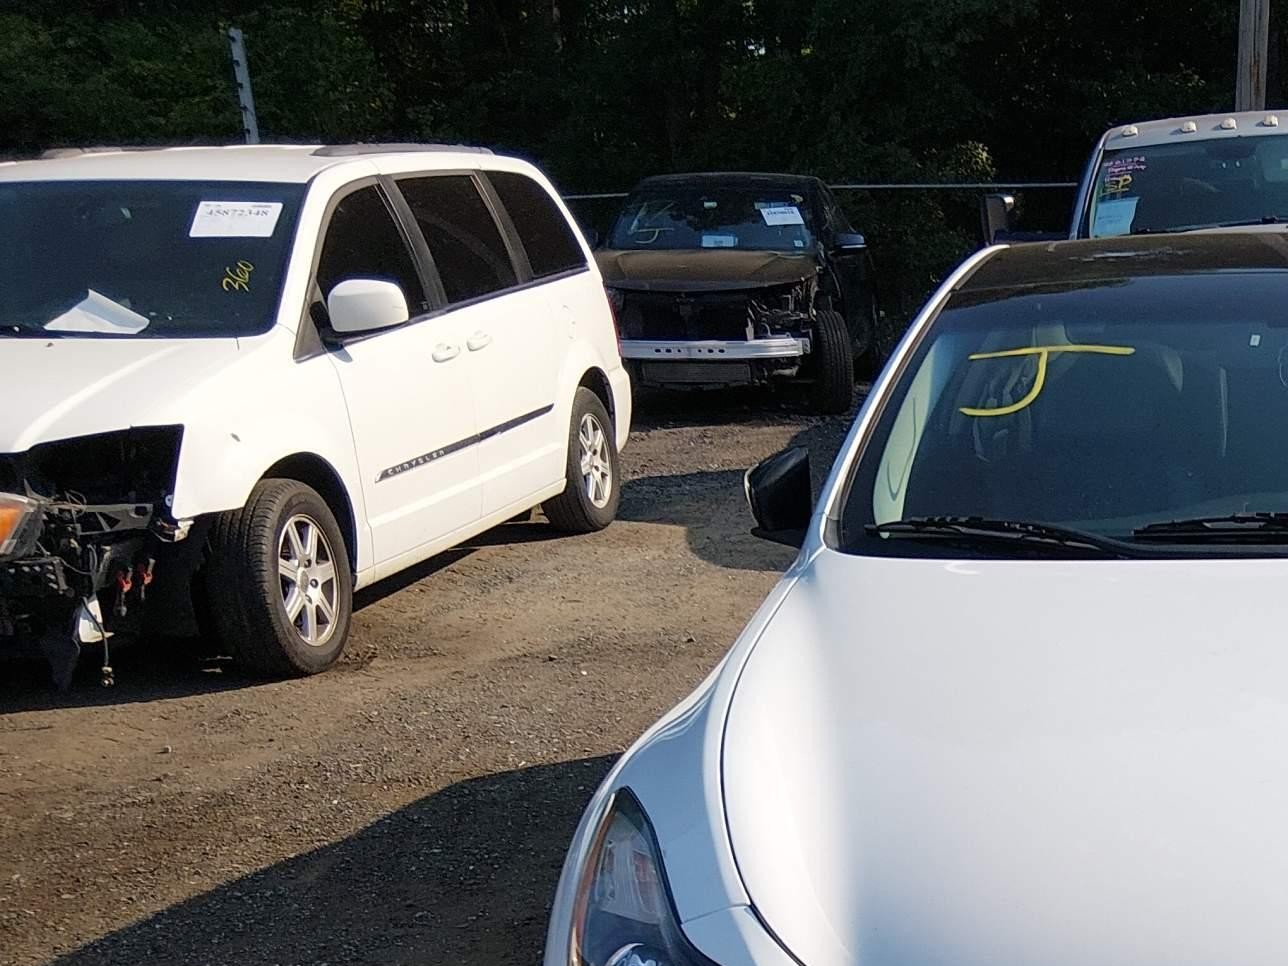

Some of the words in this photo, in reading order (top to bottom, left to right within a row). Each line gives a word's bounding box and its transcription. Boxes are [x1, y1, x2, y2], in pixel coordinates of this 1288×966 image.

[222, 260, 256, 292] 360
[959, 344, 1137, 418] J
[387, 450, 446, 476] CHRYSLER
